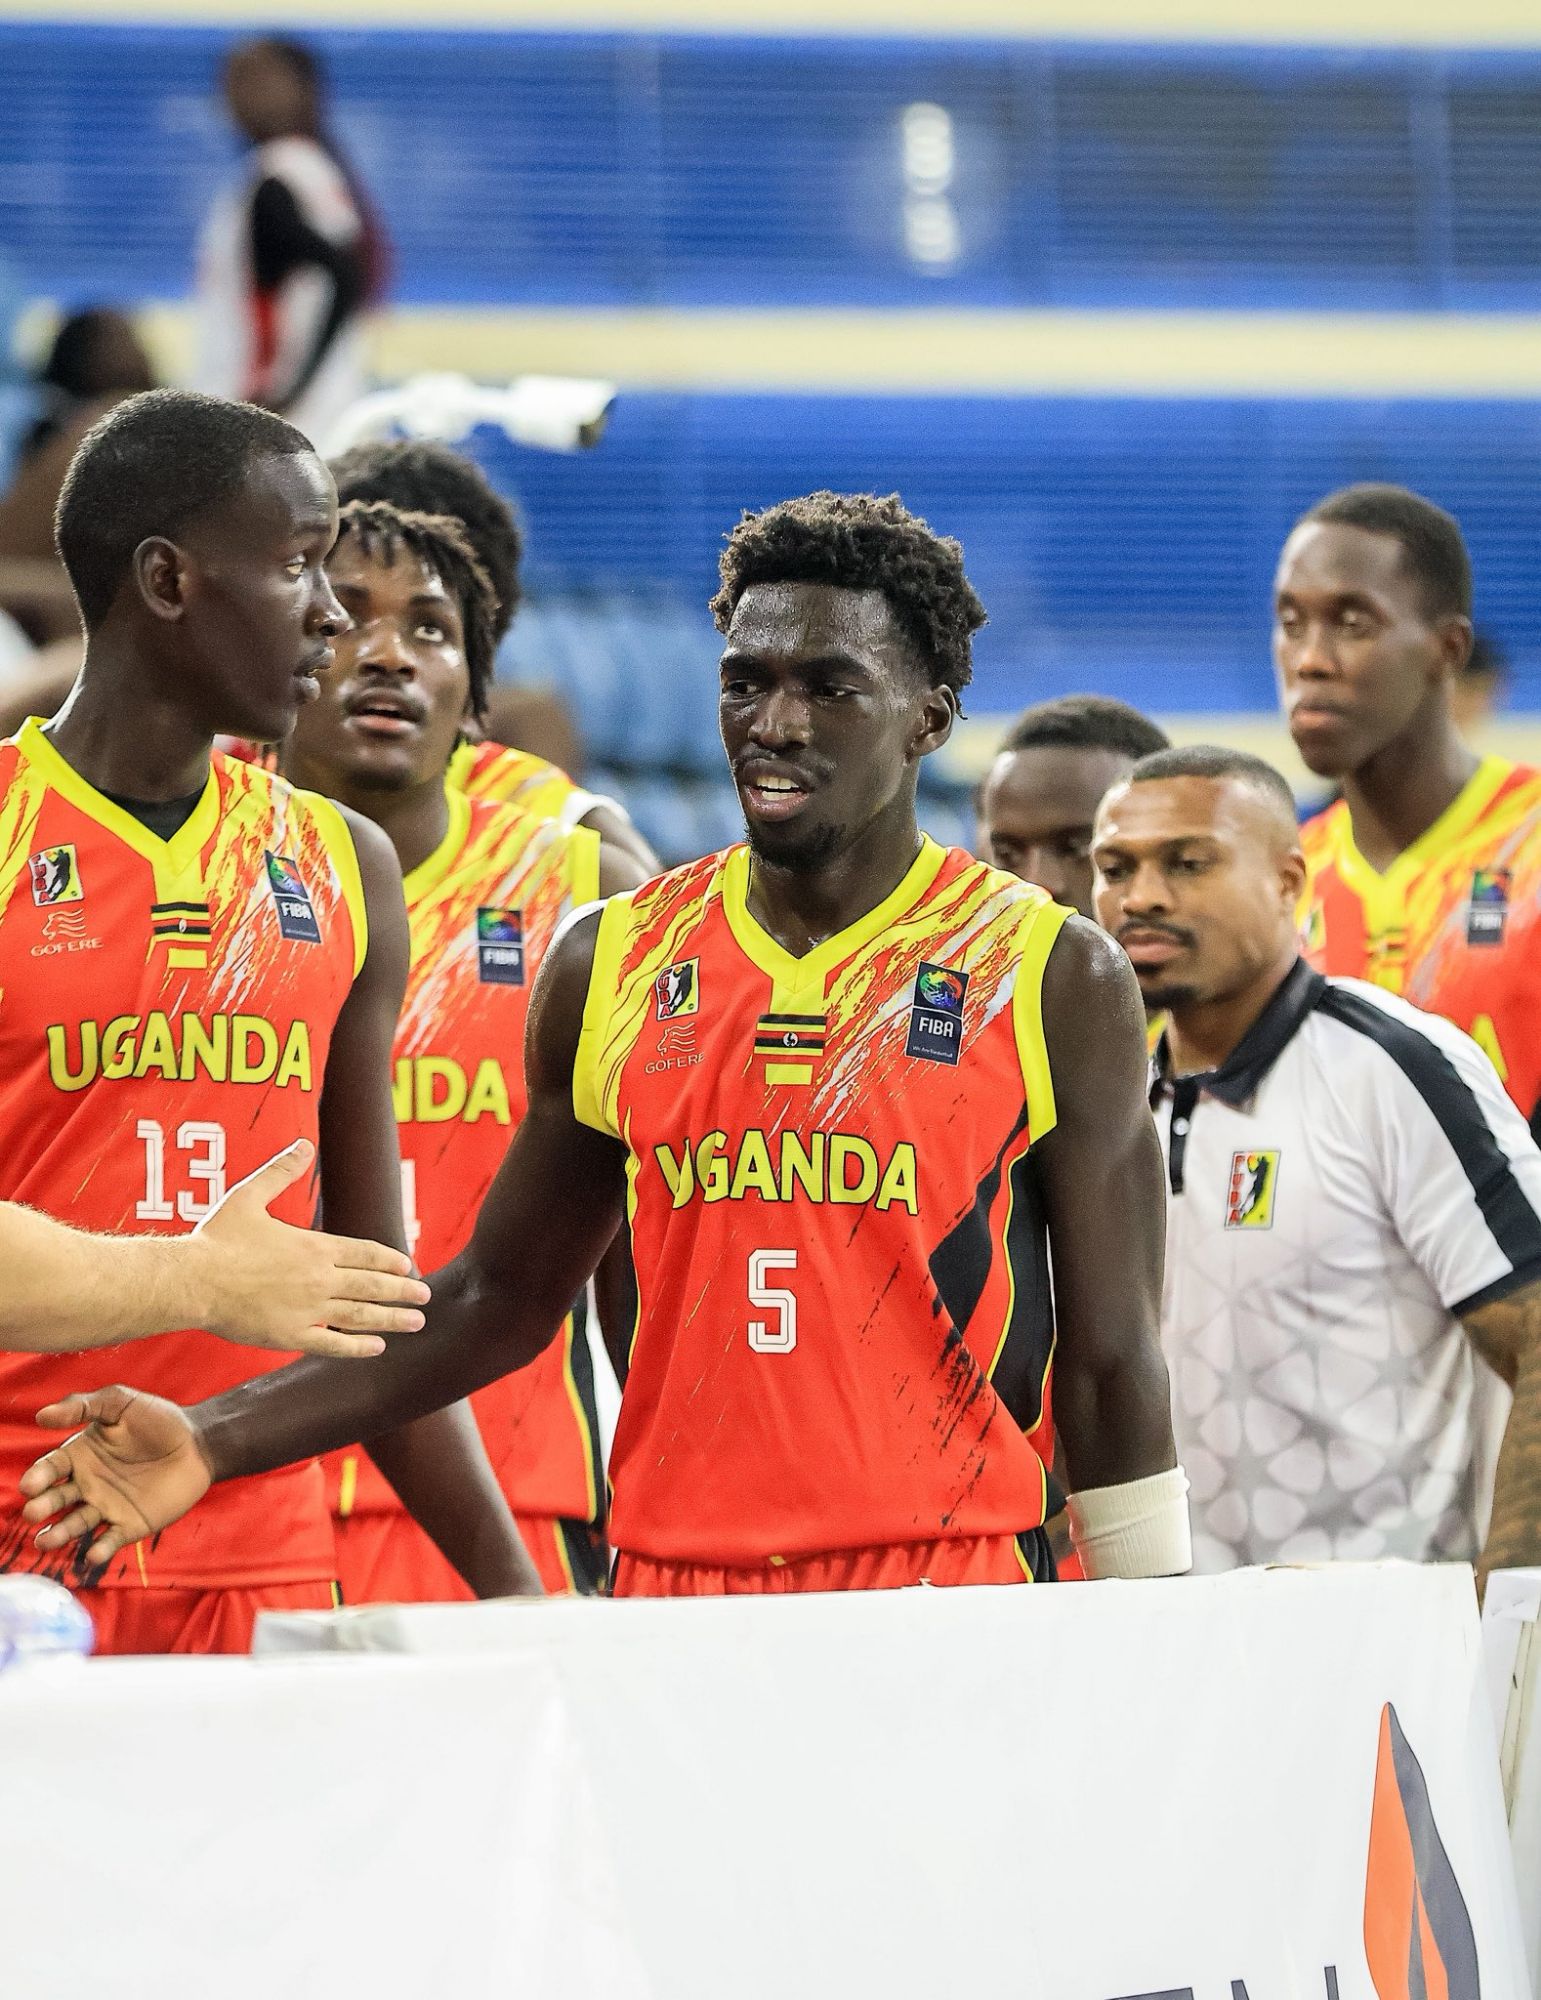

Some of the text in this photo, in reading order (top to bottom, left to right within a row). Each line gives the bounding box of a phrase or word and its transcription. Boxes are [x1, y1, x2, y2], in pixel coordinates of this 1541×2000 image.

[31, 937, 104, 957] GOFERE
[47, 1011, 312, 1092] UGANDA
[645, 1052, 705, 1074] GOFERE
[918, 1016, 954, 1038] FIBA
[136, 1119, 226, 1222] 13
[655, 1129, 918, 1215] UGANDA
[747, 1248, 798, 1354] 5
